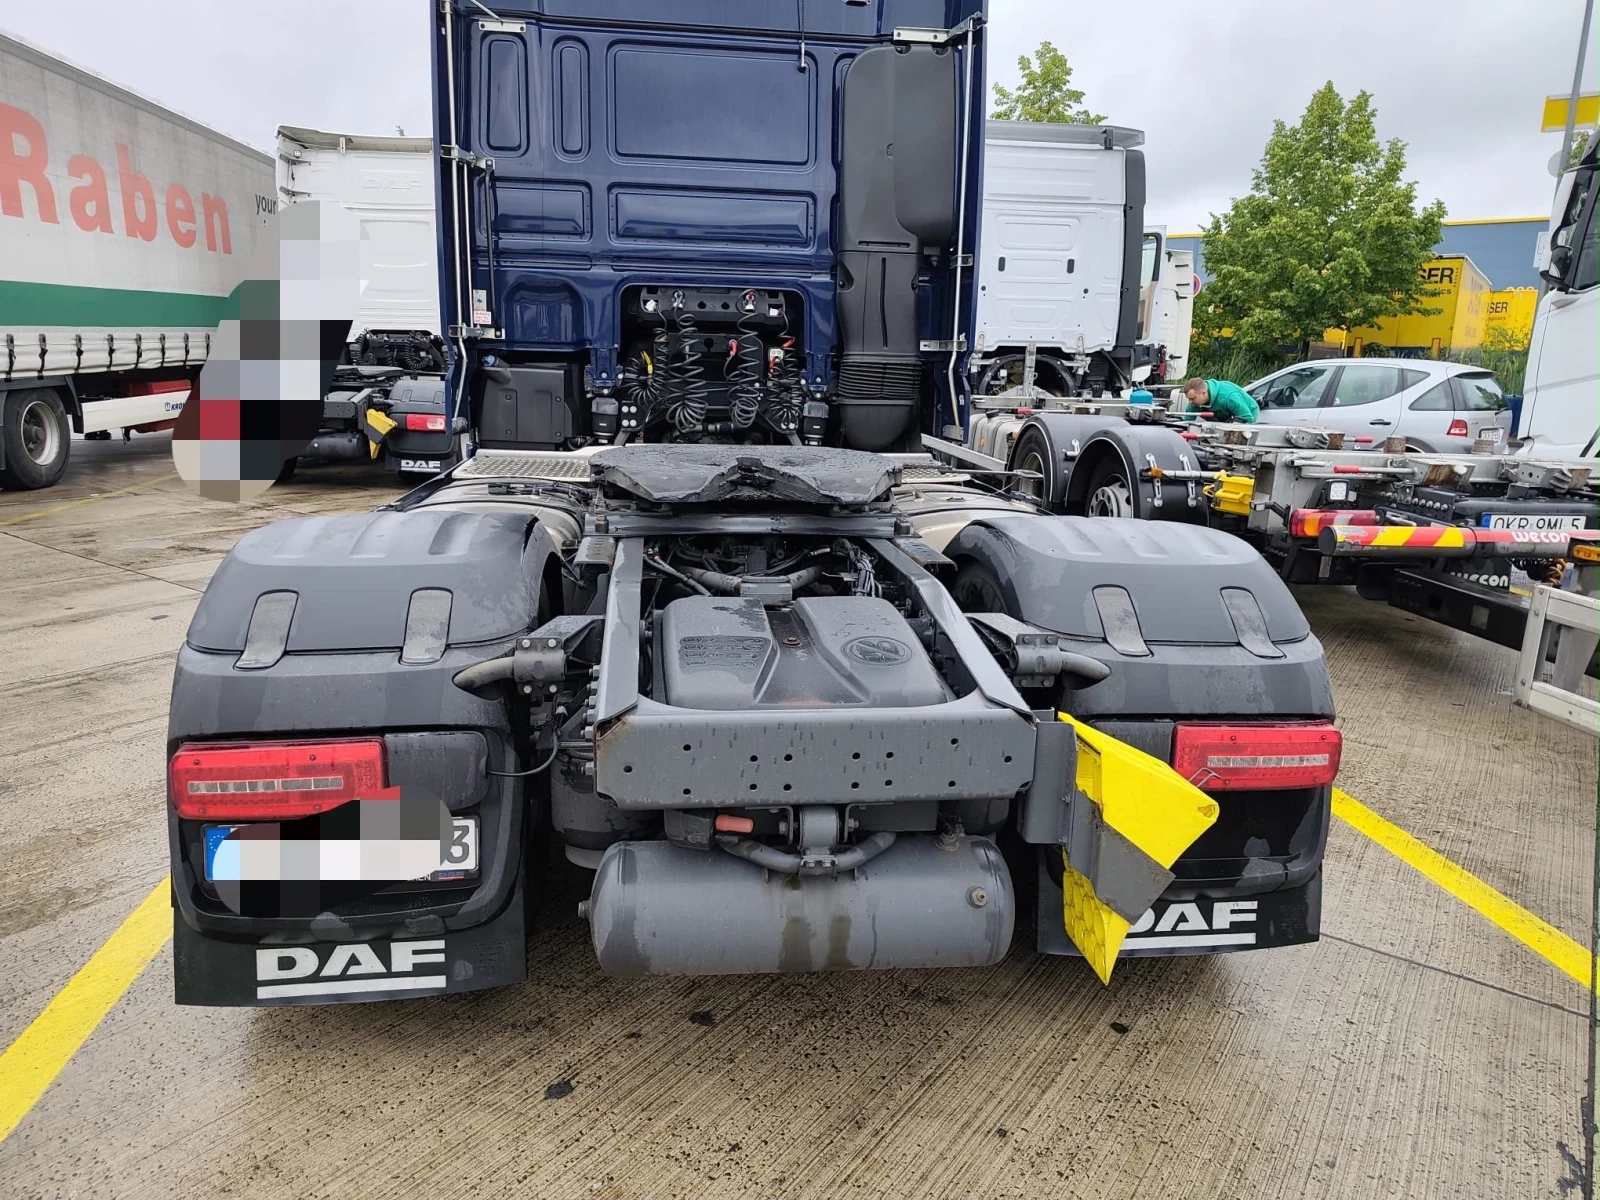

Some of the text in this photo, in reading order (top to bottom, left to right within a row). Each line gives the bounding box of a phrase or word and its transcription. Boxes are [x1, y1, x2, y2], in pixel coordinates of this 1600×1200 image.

[0, 103, 232, 255] Raben
[255, 193, 277, 216] your
[400, 459, 441, 468] DAF
[1511, 530, 1570, 543] wecon
[256, 939, 446, 981] DAF
